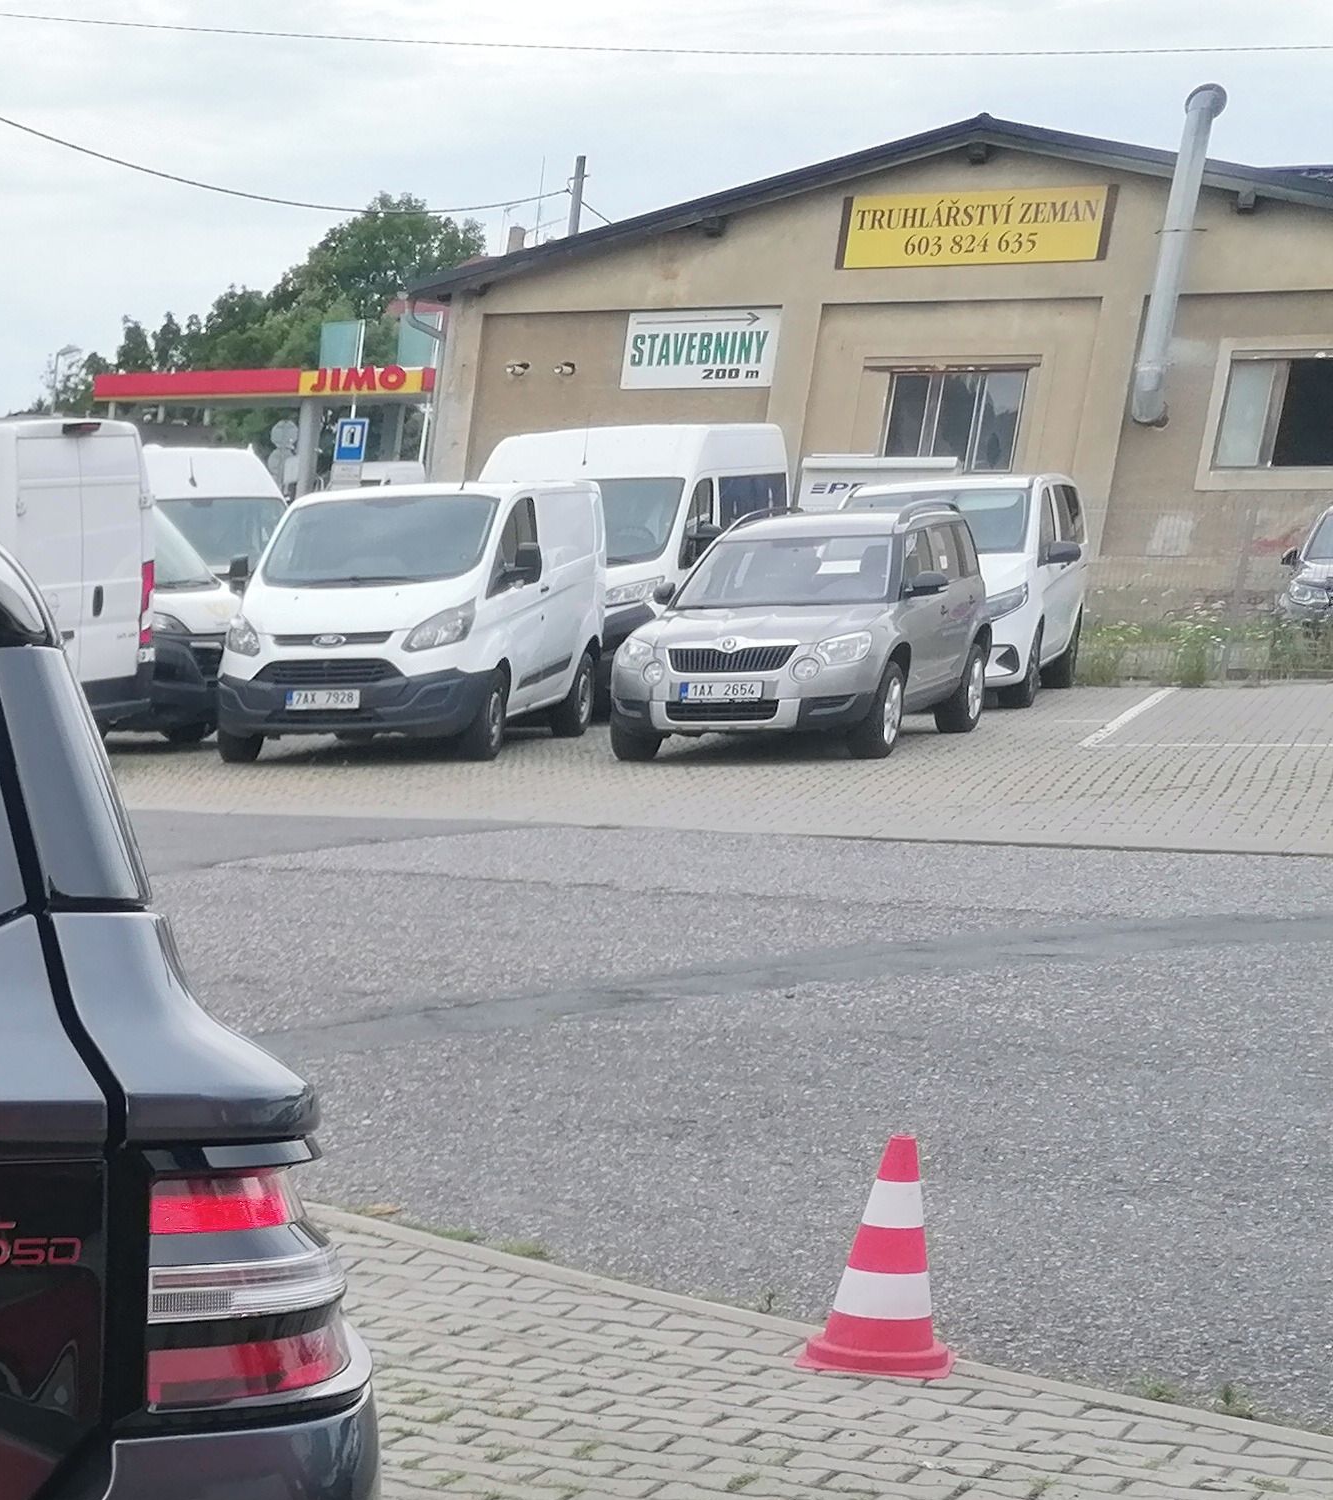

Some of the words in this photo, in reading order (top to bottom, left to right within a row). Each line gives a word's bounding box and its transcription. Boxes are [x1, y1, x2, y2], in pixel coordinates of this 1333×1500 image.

[856, 196, 1015, 231] TRUHLÁŘSTVÍ
[1018, 199, 1100, 224] ZEMAN
[904, 234, 942, 257] 603
[949, 232, 989, 254] 824
[997, 231, 1039, 253] 635
[630, 330, 769, 367] STAVEBNINY
[310, 364, 407, 392] JIMO
[702, 368, 740, 380] 200
[745, 370, 759, 379] m
[295, 692, 317, 704] 7AX
[325, 691, 354, 704] 7928
[692, 684, 714, 697] 1AX
[724, 683, 755, 696] 2654
